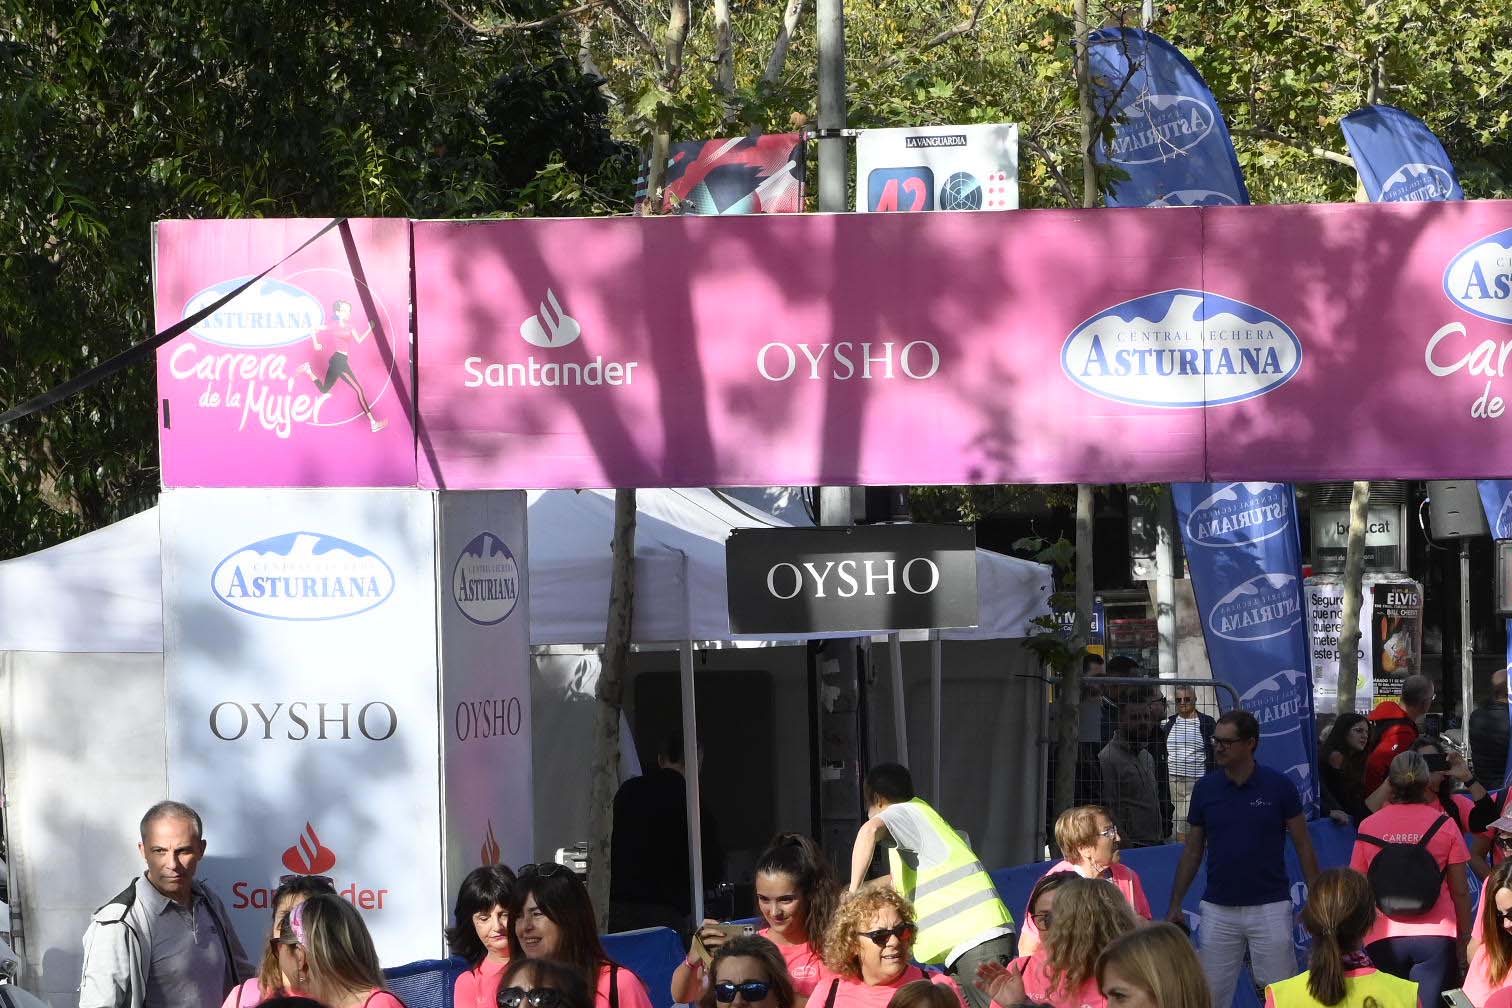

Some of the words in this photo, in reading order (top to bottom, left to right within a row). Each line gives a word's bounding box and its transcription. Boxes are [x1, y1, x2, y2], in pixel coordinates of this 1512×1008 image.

[1117, 330, 1192, 342] CENTRAL
[1200, 329, 1275, 341] LECHERA
[170, 342, 287, 380] Carrera
[463, 356, 637, 387] Santander
[757, 340, 940, 381] OYSHO
[1080, 334, 1283, 377] ASTURIANA
[200, 381, 219, 407] de
[225, 381, 240, 407] la
[239, 376, 332, 439] Mujer
[1470, 381, 1506, 419] de
[226, 565, 381, 598] ASTURIANA
[458, 567, 516, 602] ASTURIANA
[767, 557, 939, 598] OYSHO
[1312, 609, 1329, 620] que
[1387, 593, 1417, 605] ELVIS
[1314, 649, 1332, 659] este
[209, 701, 398, 741] OYSHO
[456, 696, 522, 741] OYSHO
[232, 882, 389, 910] Sader
